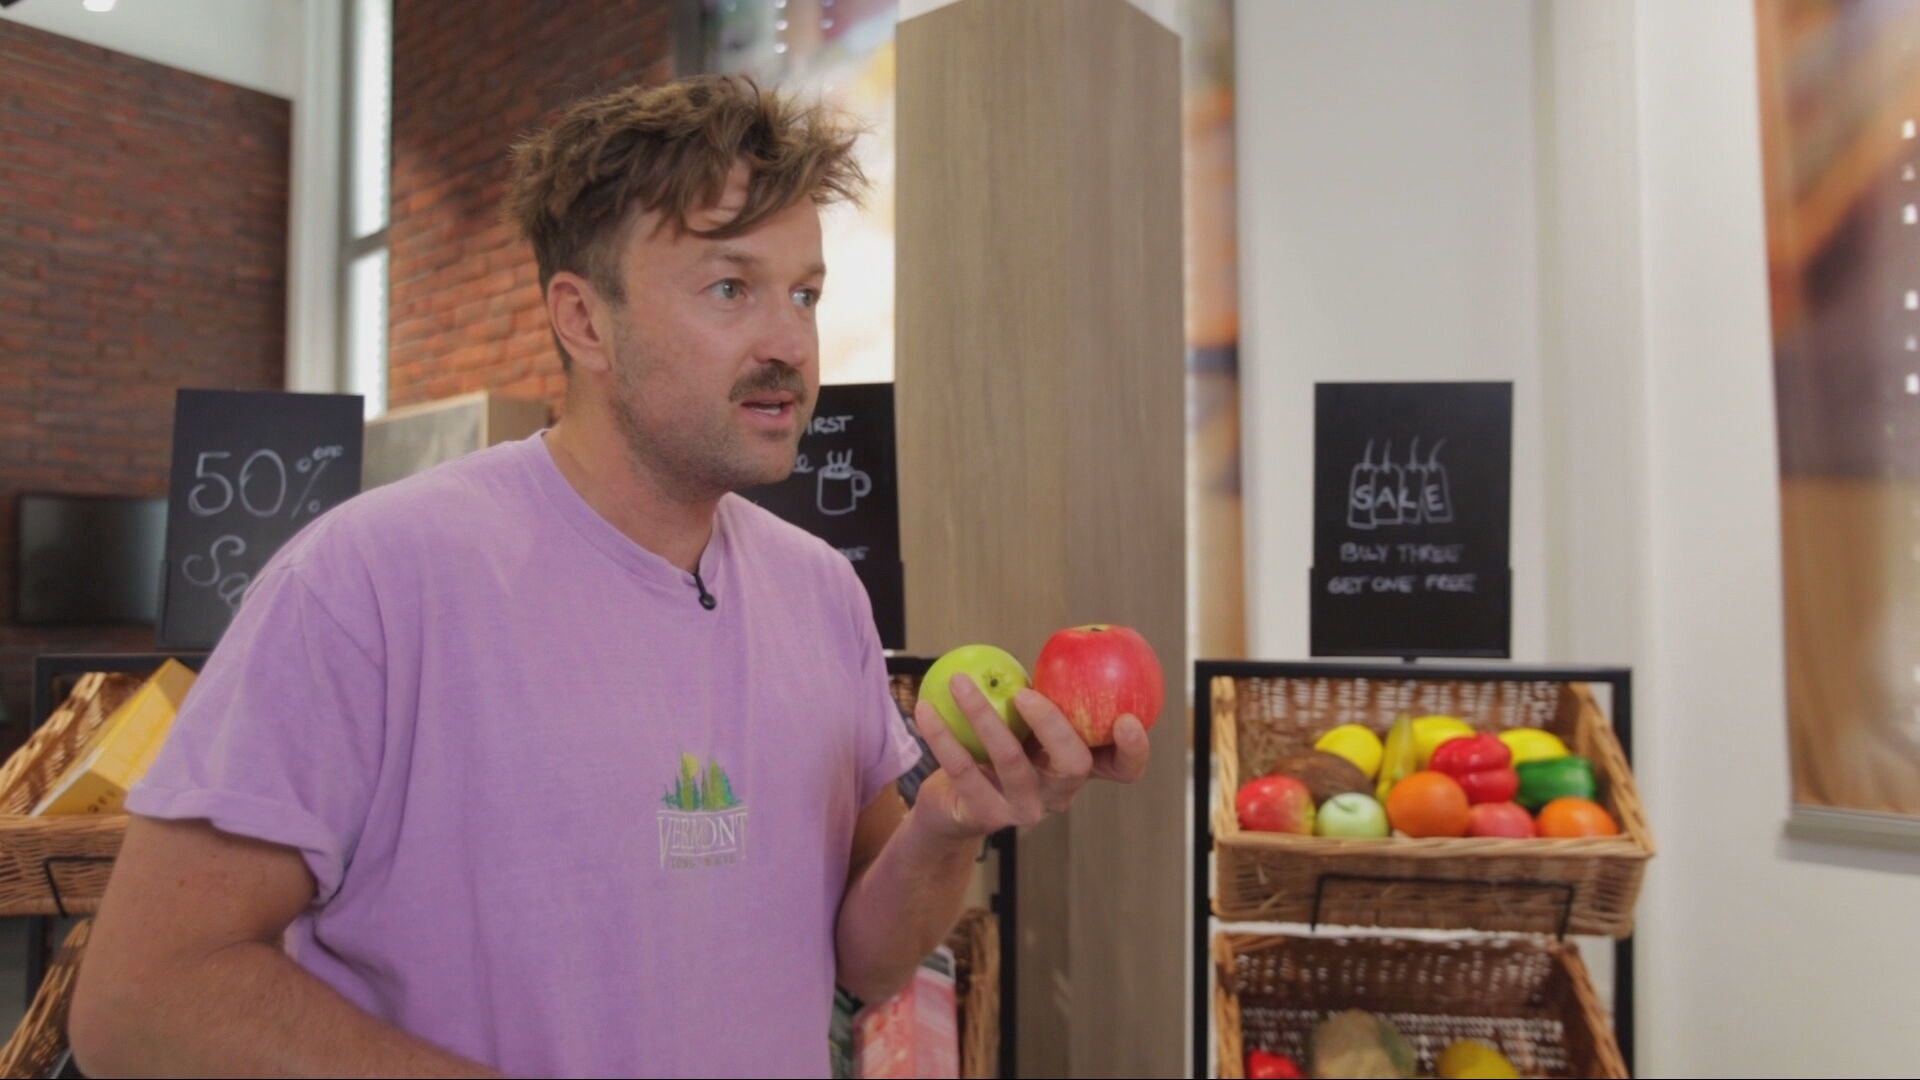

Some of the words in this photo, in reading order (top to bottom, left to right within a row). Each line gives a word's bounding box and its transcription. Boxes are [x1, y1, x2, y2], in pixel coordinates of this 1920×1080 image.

[807, 415, 853, 435] IRST
[188, 449, 332, 519] 50%
[1352, 485, 1444, 510] SALE
[182, 535, 251, 608] Sa
[657, 812, 748, 868] VERMONT
